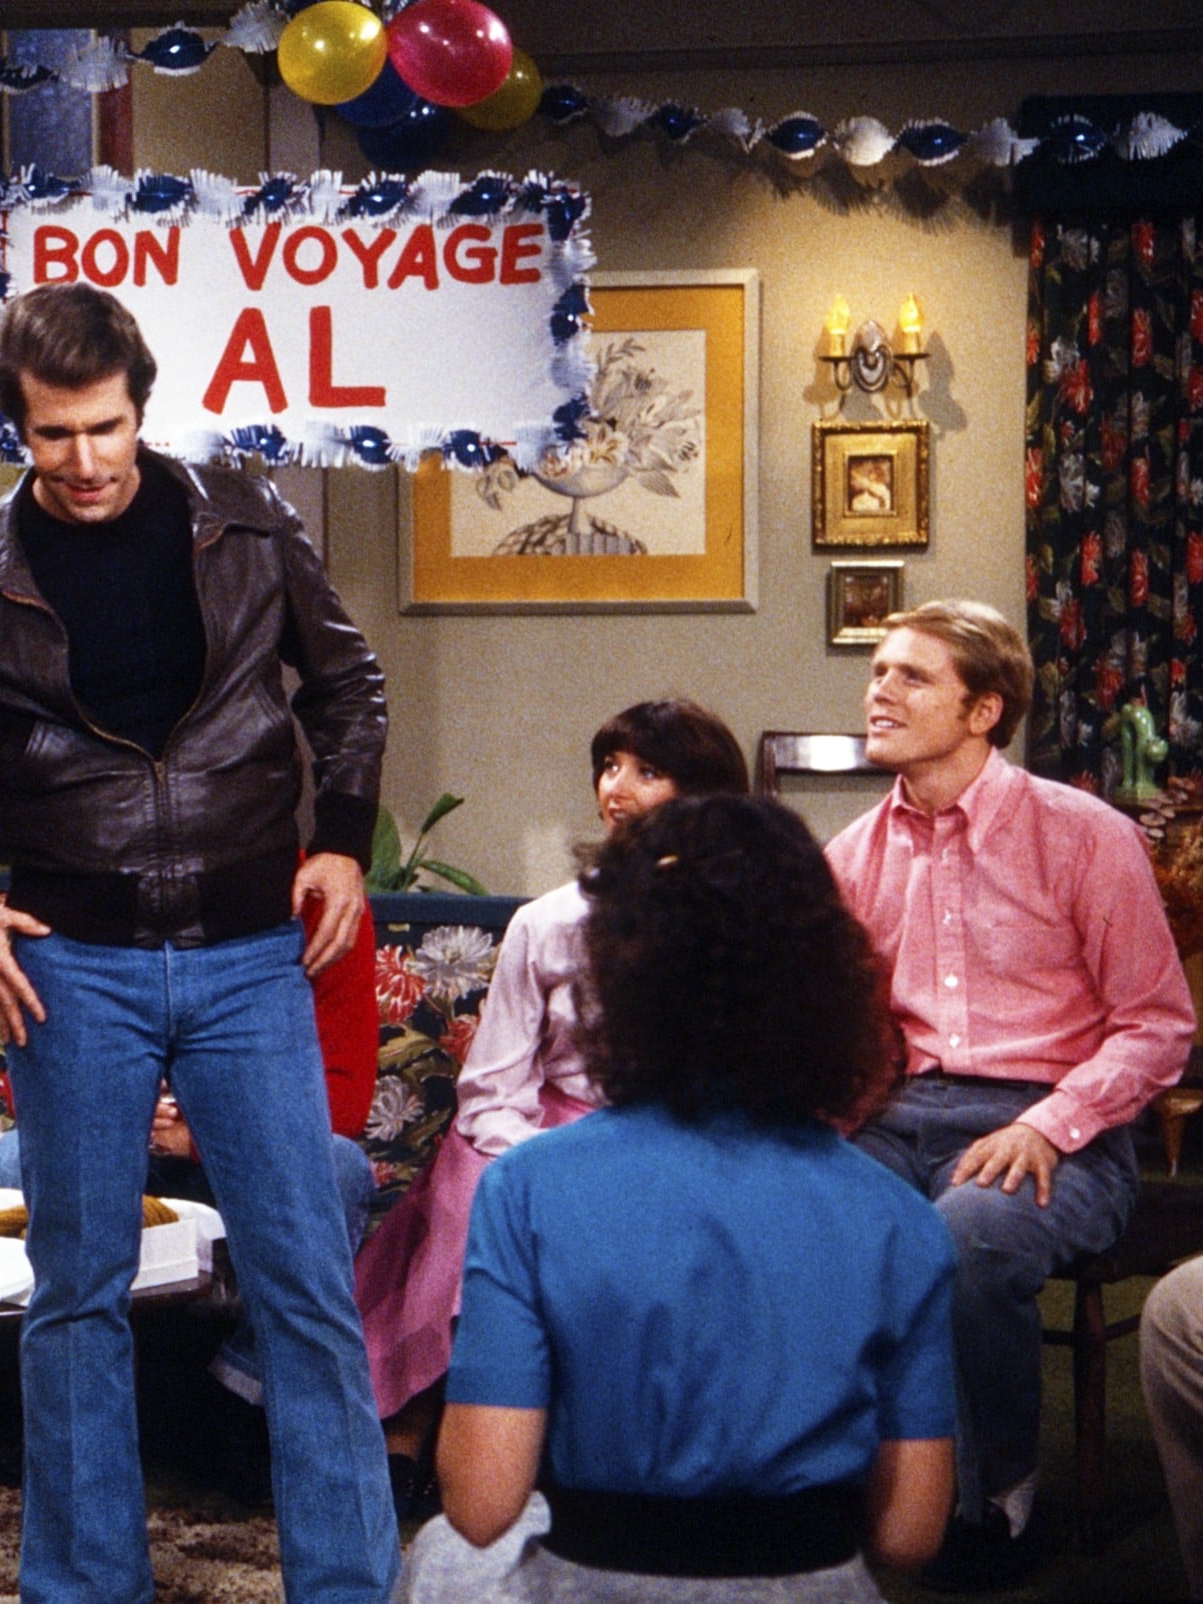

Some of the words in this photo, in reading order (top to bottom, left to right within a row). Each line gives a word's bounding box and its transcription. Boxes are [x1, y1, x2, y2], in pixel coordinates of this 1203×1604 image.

[33, 224, 182, 289] BON
[229, 221, 545, 291] VOYAGE
[202, 305, 386, 415] AL
